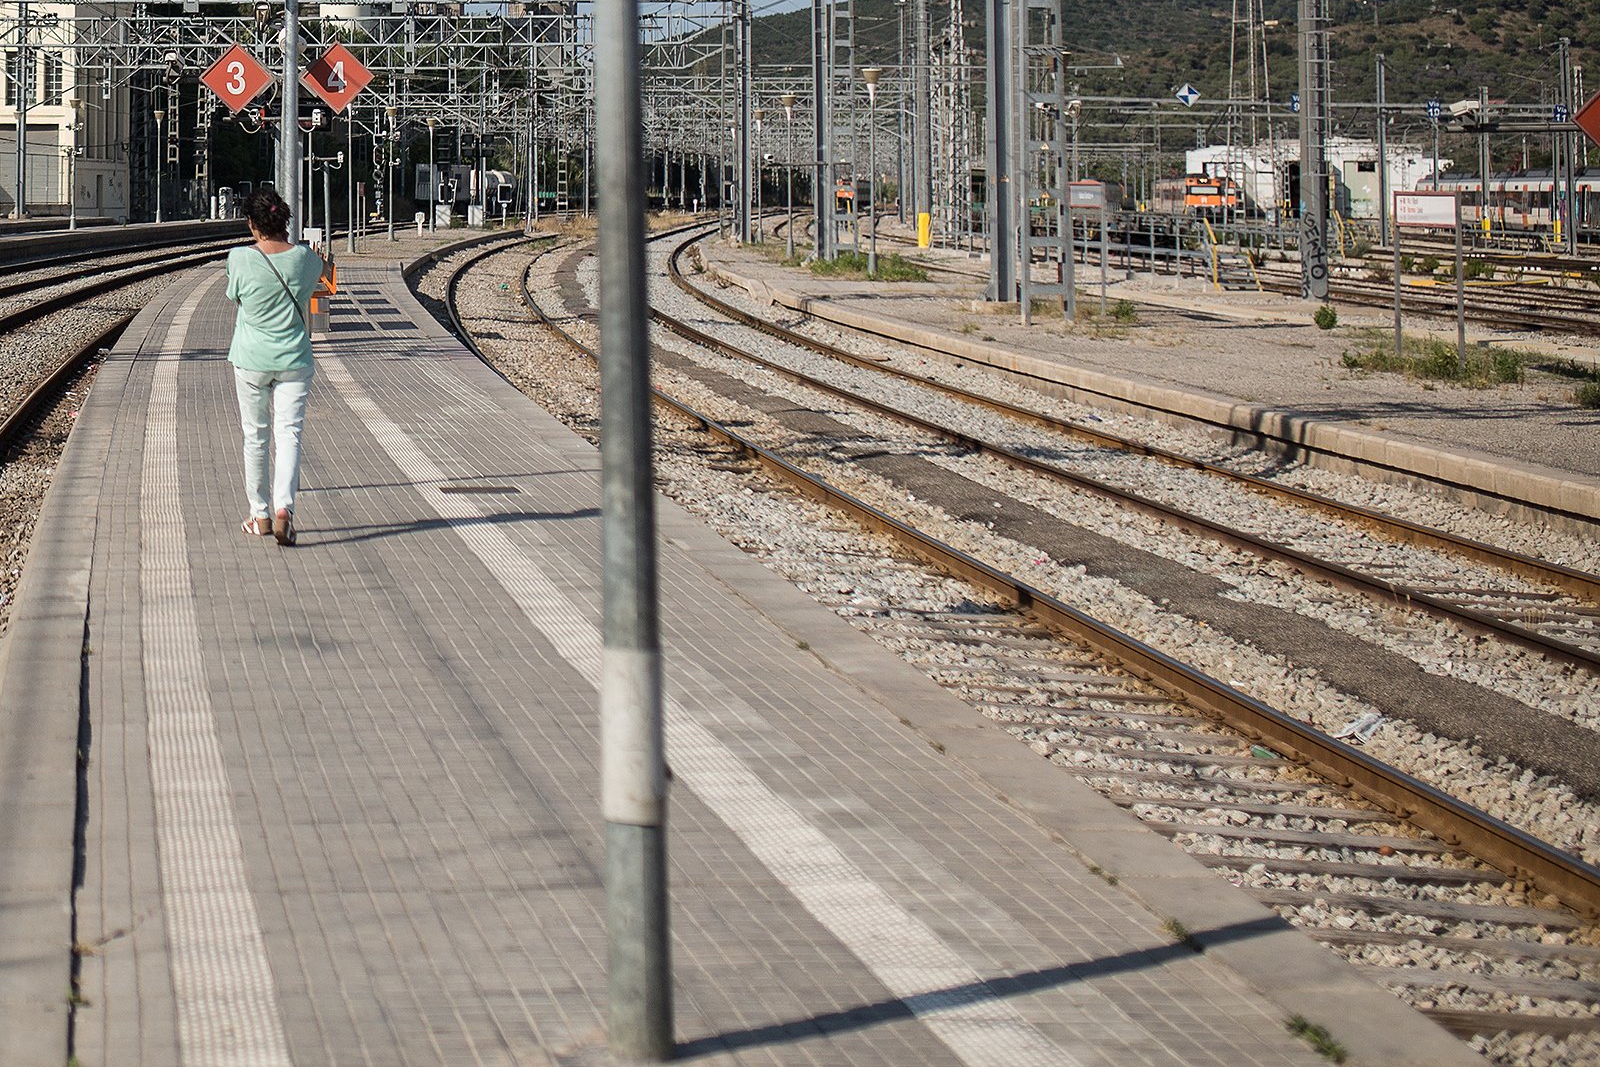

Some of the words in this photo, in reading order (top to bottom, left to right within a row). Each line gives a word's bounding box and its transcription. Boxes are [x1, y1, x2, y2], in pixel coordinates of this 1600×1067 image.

[226, 61, 246, 95] 3
[327, 61, 348, 94] 4
[1293, 102, 1300, 112] 9
[1428, 108, 1440, 117] 10
[1555, 113, 1566, 123] 11
